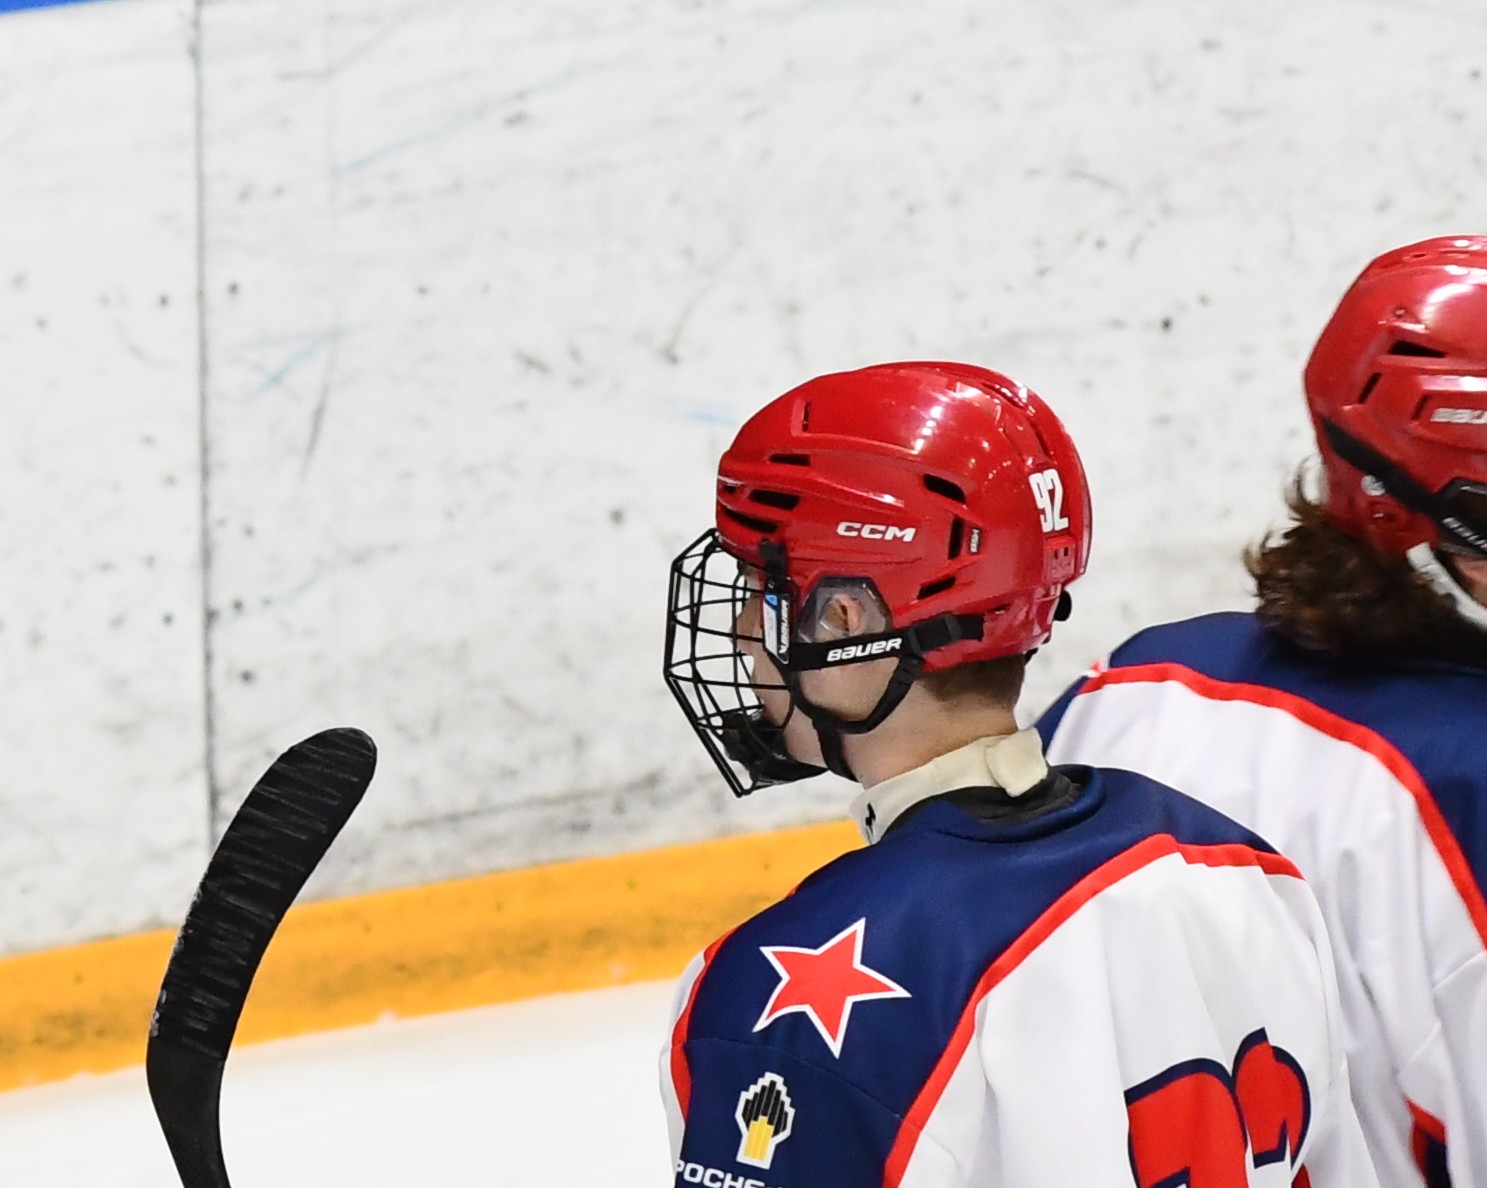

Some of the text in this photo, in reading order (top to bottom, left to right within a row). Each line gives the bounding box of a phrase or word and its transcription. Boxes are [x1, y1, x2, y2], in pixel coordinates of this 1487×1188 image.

[1029, 468, 1070, 534] 92
[836, 521, 917, 542] CCM
[826, 637, 903, 663] BAUER
